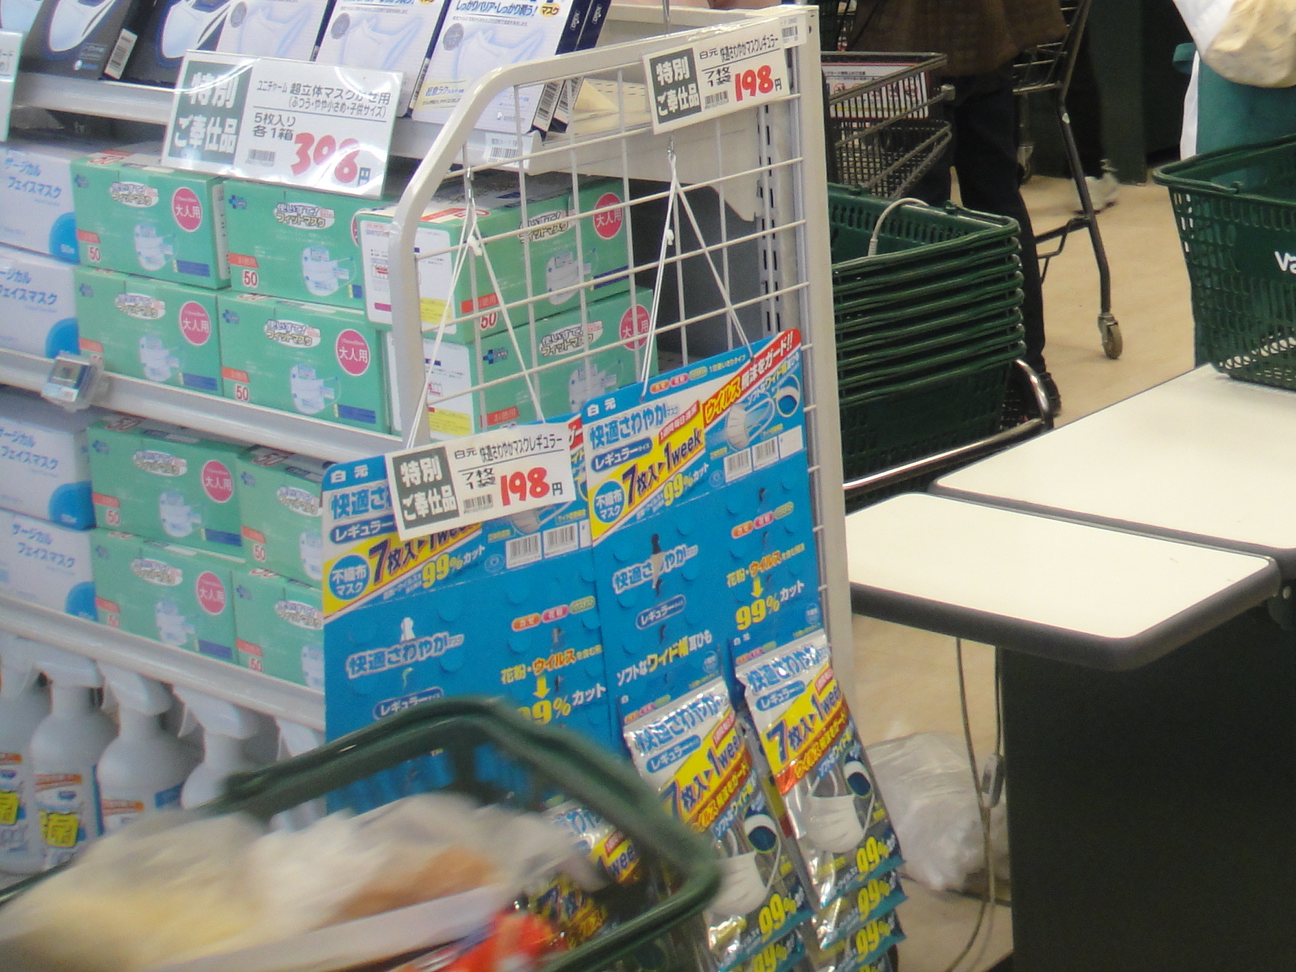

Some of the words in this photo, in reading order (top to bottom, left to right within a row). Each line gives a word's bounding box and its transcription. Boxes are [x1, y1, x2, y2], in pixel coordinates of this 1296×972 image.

[655, 55, 691, 87] 特別
[188, 71, 240, 109] 特別
[734, 64, 774, 103] 198
[656, 82, 700, 117] ご奉仕品
[253, 111, 297, 128] 5枚入り
[173, 113, 239, 155] ご奉仕品
[252, 124, 295, 141] 各1箱
[174, 203, 201, 220] 大人用
[480, 312, 497, 330] 50
[338, 346, 368, 364] 大人用
[400, 455, 442, 488] 特別
[204, 475, 232, 492] 大人用
[499, 466, 550, 507] 198
[330, 486, 390, 521] 快適さ
[402, 485, 458, 522] ご奉仕品
[595, 490, 622, 508] 不織布
[600, 504, 621, 519] マスク
[331, 564, 367, 583] 不織布
[335, 580, 363, 596] マスク
